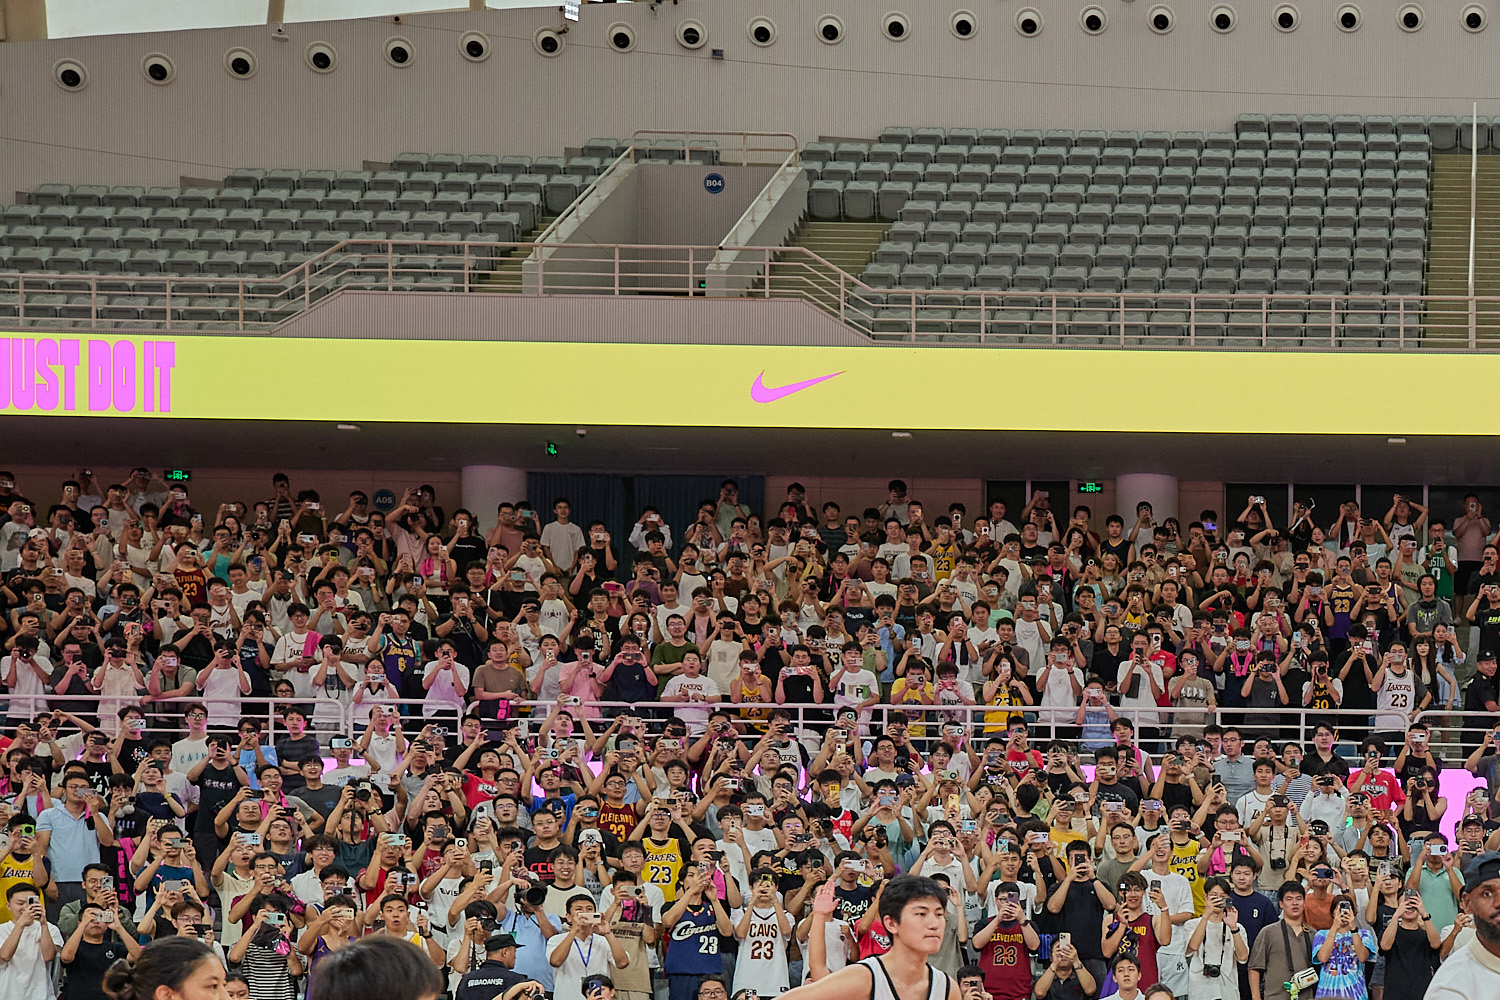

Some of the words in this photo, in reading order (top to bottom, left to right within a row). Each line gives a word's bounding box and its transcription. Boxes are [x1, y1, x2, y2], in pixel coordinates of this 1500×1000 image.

[706, 179, 722, 187] B04
[88, 339, 136, 412] DO
[143, 341, 176, 412] IT
[375, 496, 393, 505] A05
[936, 559, 950, 572] 23
[184, 583, 197, 596] 23
[1335, 600, 1350, 613] 23
[1391, 694, 1408, 708] 23
[650, 866, 672, 884] 23
[672, 919, 718, 941] CLEVELAND
[749, 923, 777, 938] CAVS
[989, 932, 1024, 944] CLEVELAND
[699, 936, 718, 955] 23
[751, 940, 776, 960] 23
[993, 946, 1017, 966] 23
